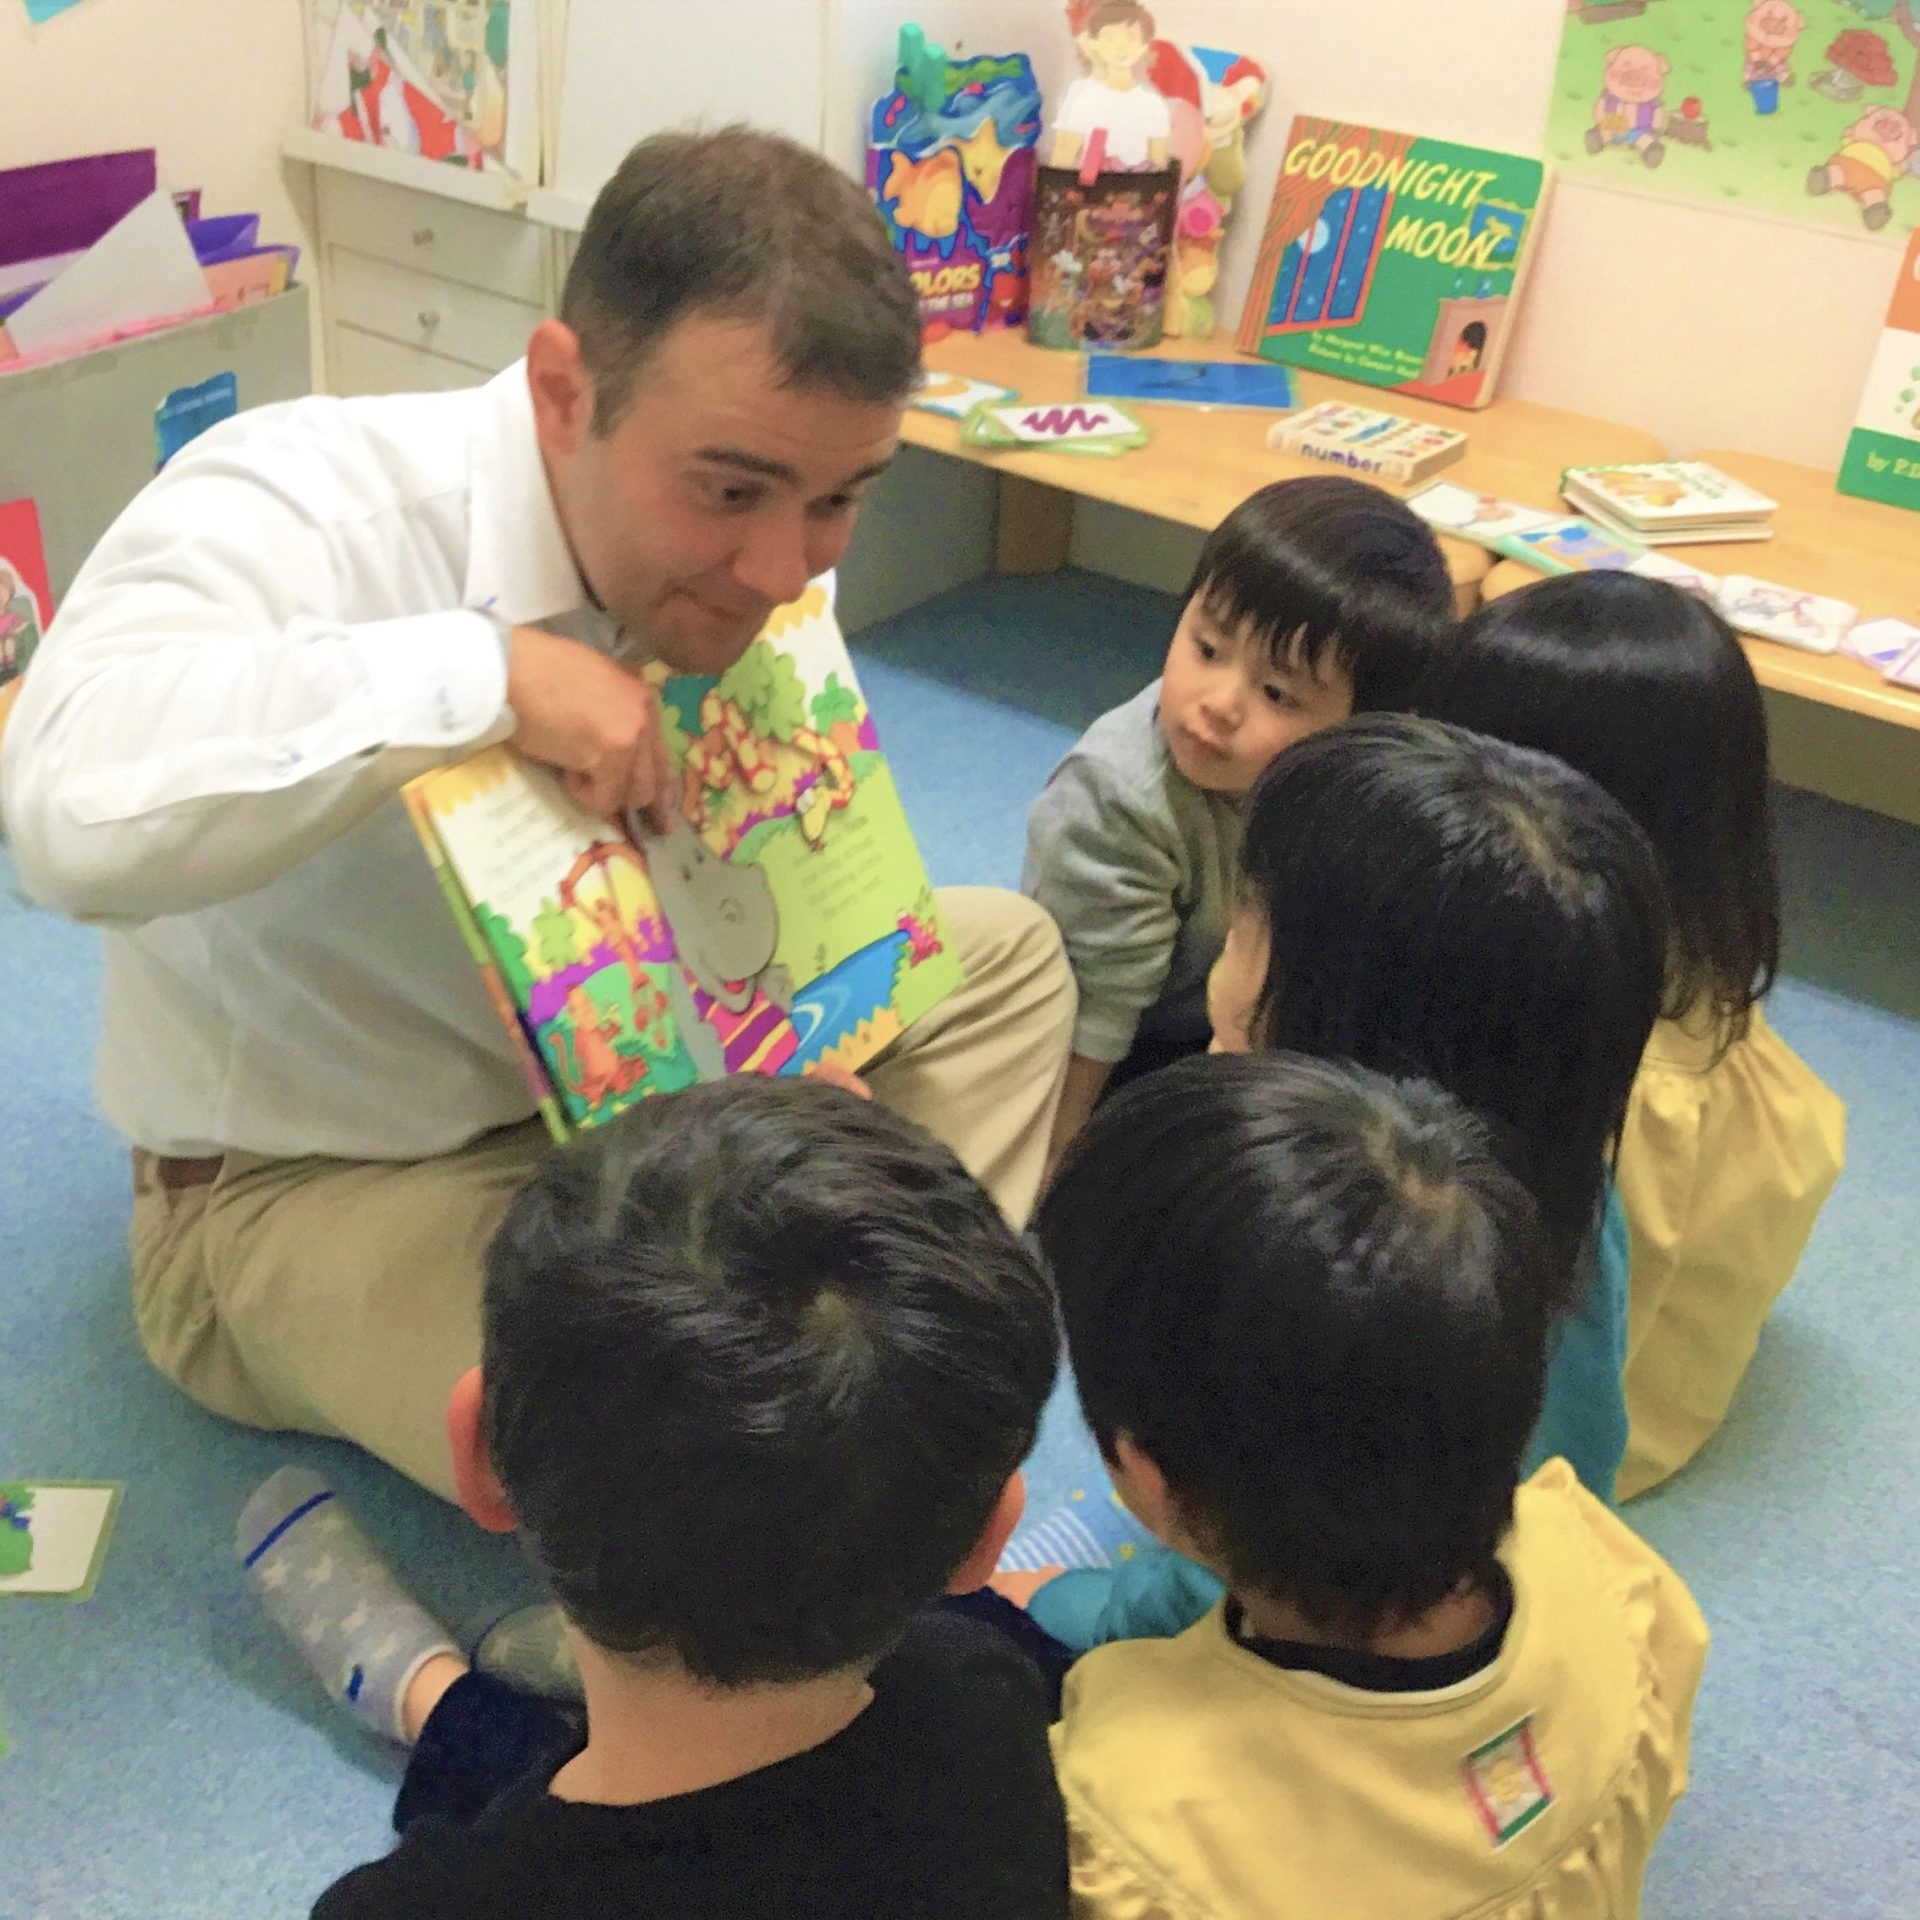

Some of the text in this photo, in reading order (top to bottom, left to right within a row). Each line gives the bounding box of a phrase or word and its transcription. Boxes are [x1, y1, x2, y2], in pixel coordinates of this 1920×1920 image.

[1283, 139, 1498, 209] GOODNIGHT
[1384, 215, 1506, 270] MOON
[1301, 443, 1383, 474] number
